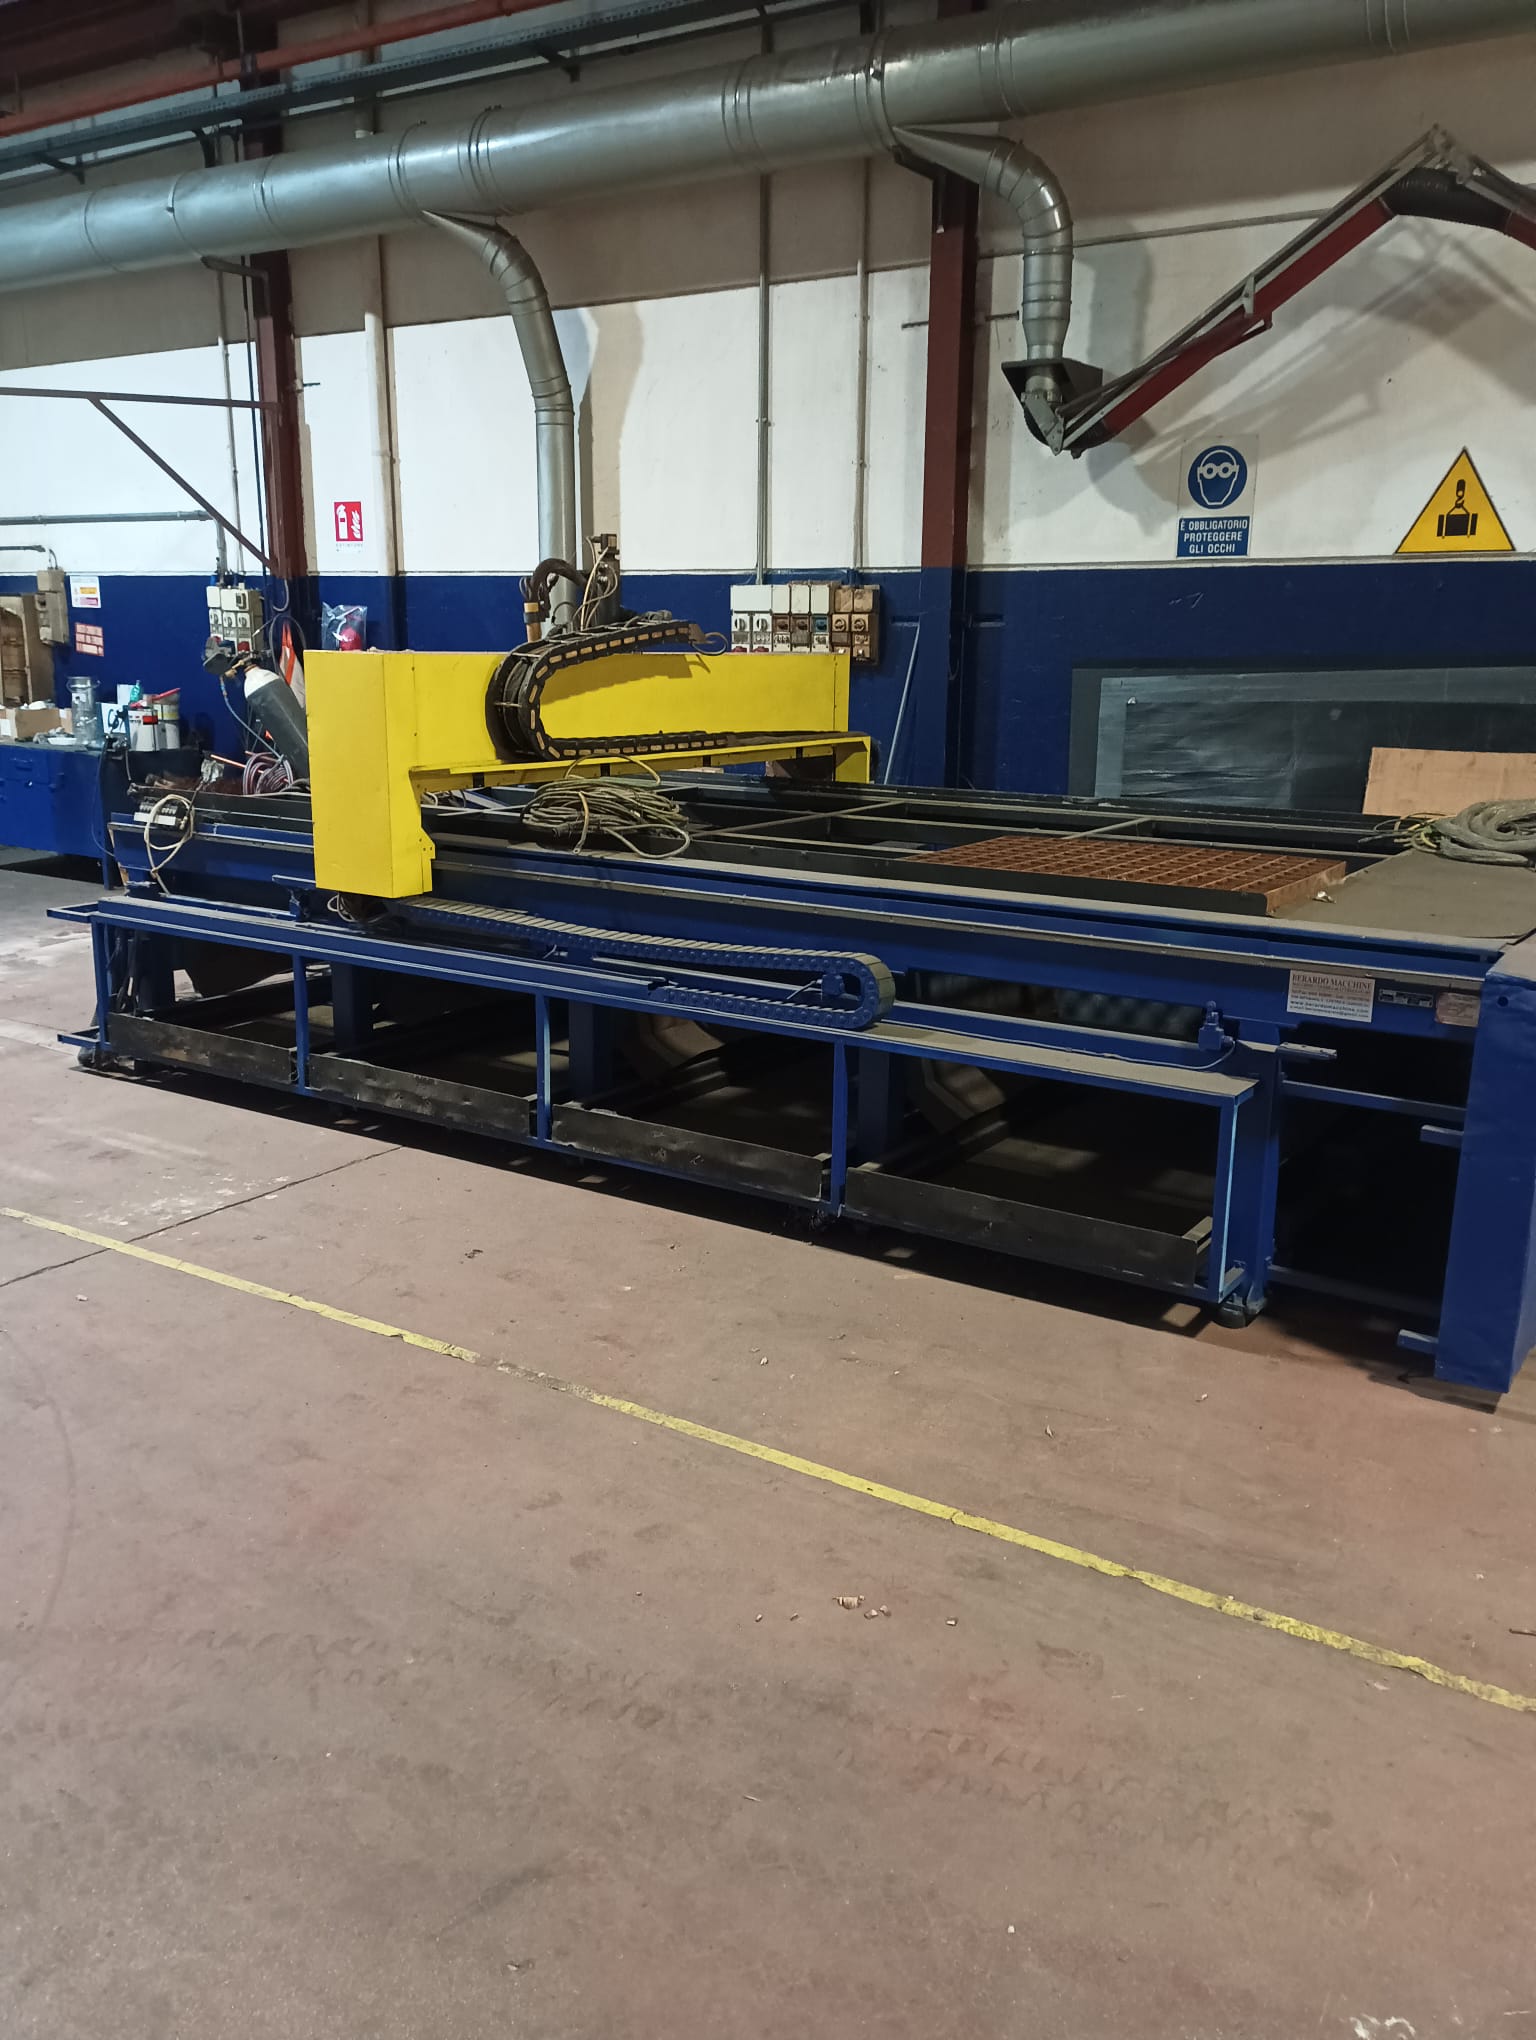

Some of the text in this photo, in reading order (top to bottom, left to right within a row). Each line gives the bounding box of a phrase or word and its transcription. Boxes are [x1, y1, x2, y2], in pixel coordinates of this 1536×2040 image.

[1180, 519, 1248, 531] È OBBLIGATORIO
[1184, 531, 1243, 542] PROTEGGERE
[1189, 543, 1235, 554] GLI OCCHI
[1330, 979, 1372, 990] MACCHINE
